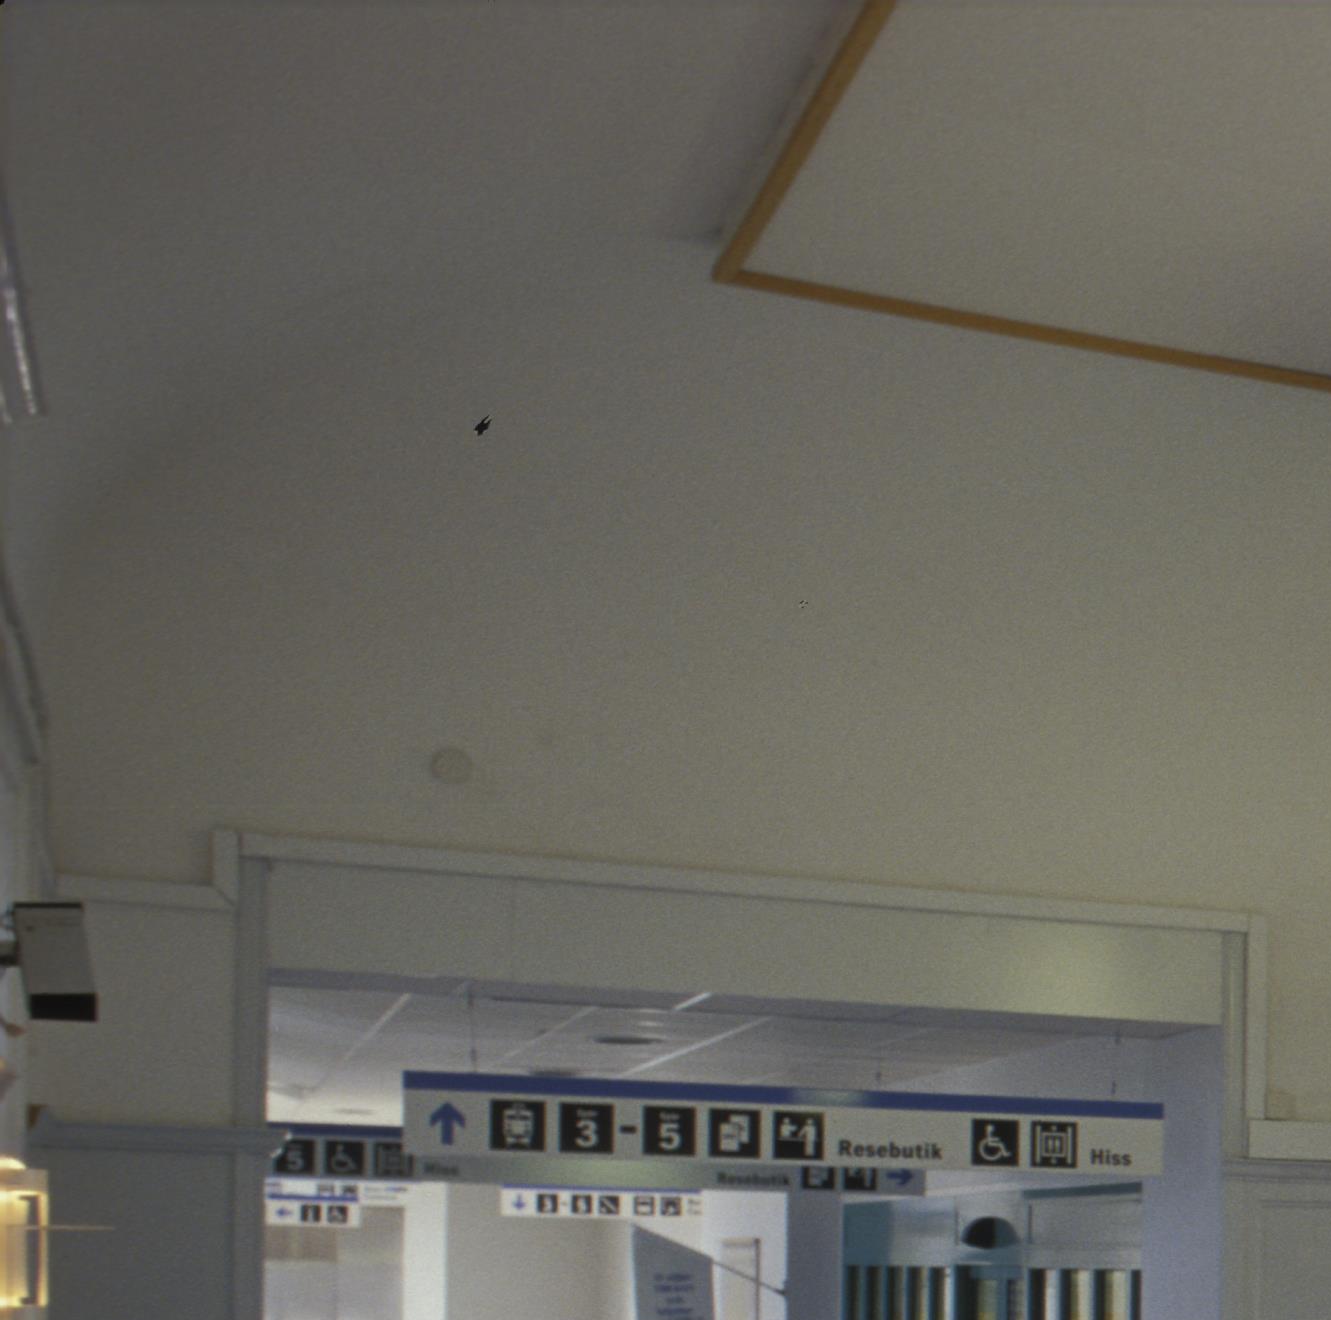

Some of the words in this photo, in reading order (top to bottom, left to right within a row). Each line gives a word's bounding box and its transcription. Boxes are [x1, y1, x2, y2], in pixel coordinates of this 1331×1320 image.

[574, 1119, 599, 1149] 3
[658, 1122, 682, 1152] 5
[837, 1139, 943, 1161] Resebutik
[1090, 1148, 1133, 1168] Hiss
